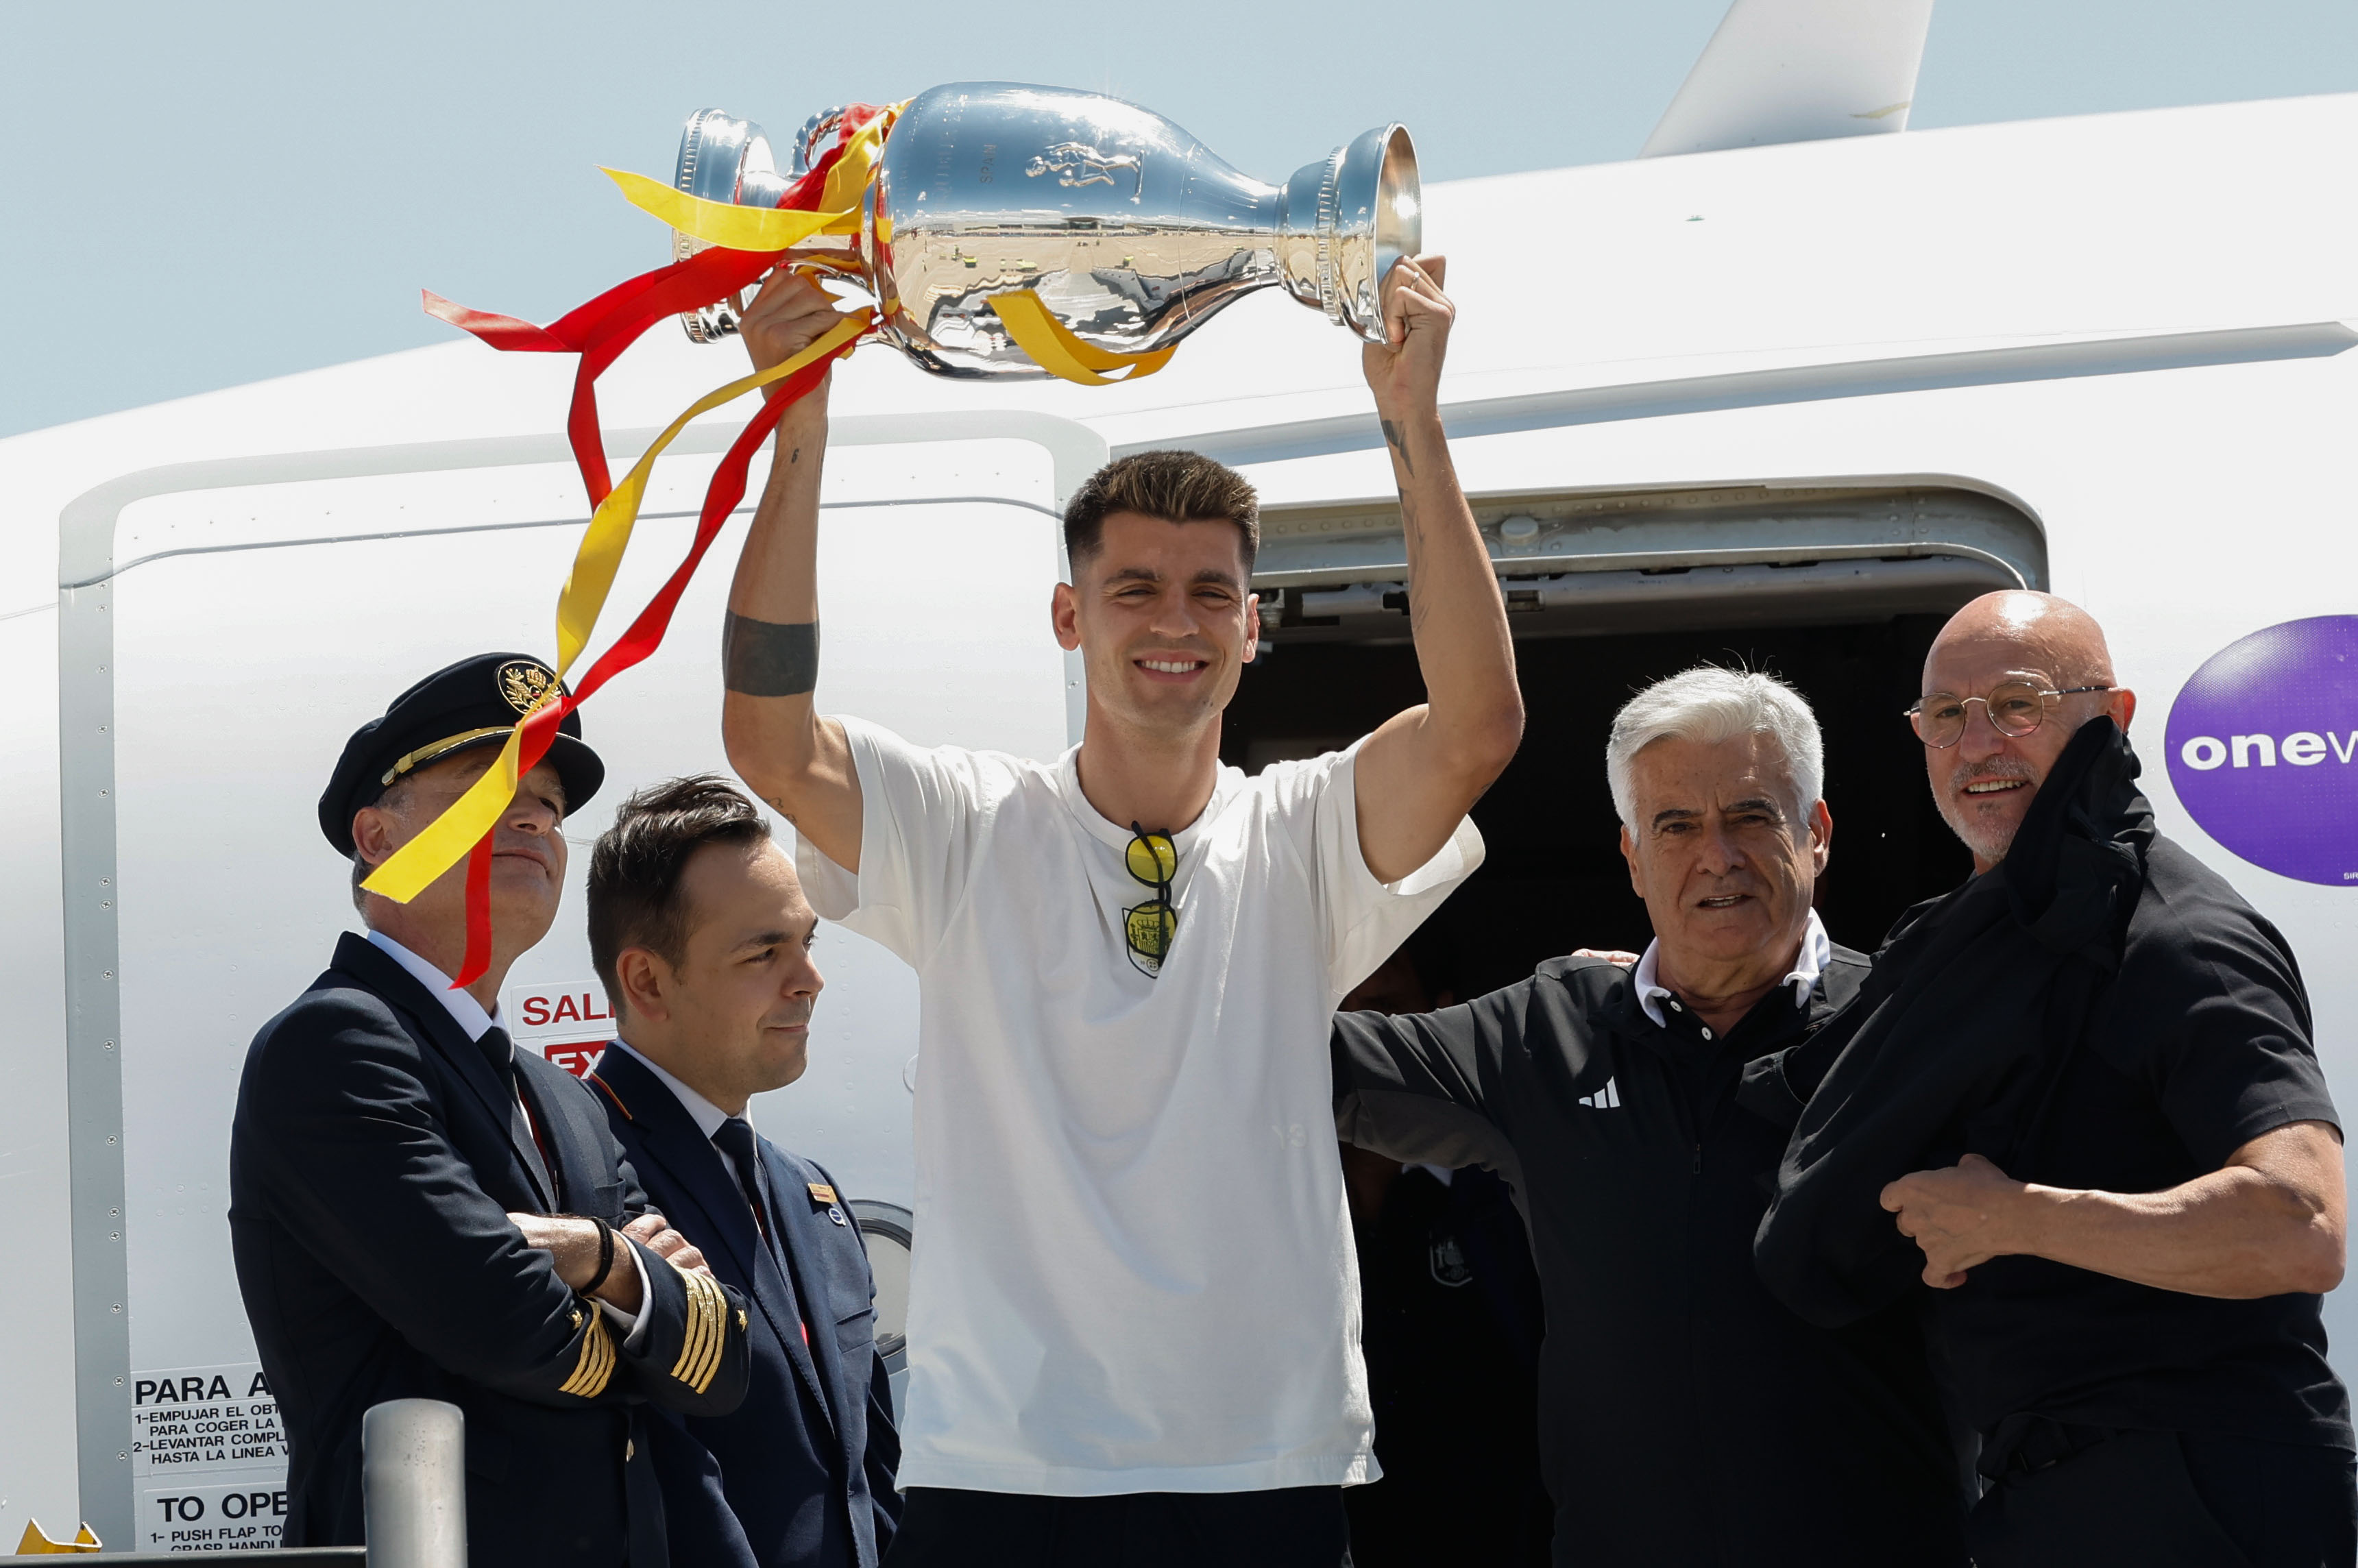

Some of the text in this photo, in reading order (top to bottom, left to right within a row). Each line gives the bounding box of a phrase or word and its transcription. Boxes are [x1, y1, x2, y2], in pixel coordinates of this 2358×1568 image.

[136, 1372, 273, 1405] PARA A
[135, 1408, 219, 1424] 1-EMPUJAR
[226, 1406, 244, 1417] EL
[150, 1418, 275, 1436] PARA COGER LA
[133, 1432, 284, 1452] 2-LEVANTAR COMPL
[151, 1451, 199, 1465] HASTA
[206, 1449, 226, 1461] LA
[232, 1446, 275, 1459] LINEA
[157, 1491, 287, 1522] TO OPE
[150, 1525, 282, 1543] 1- PUSH FLAP TO
